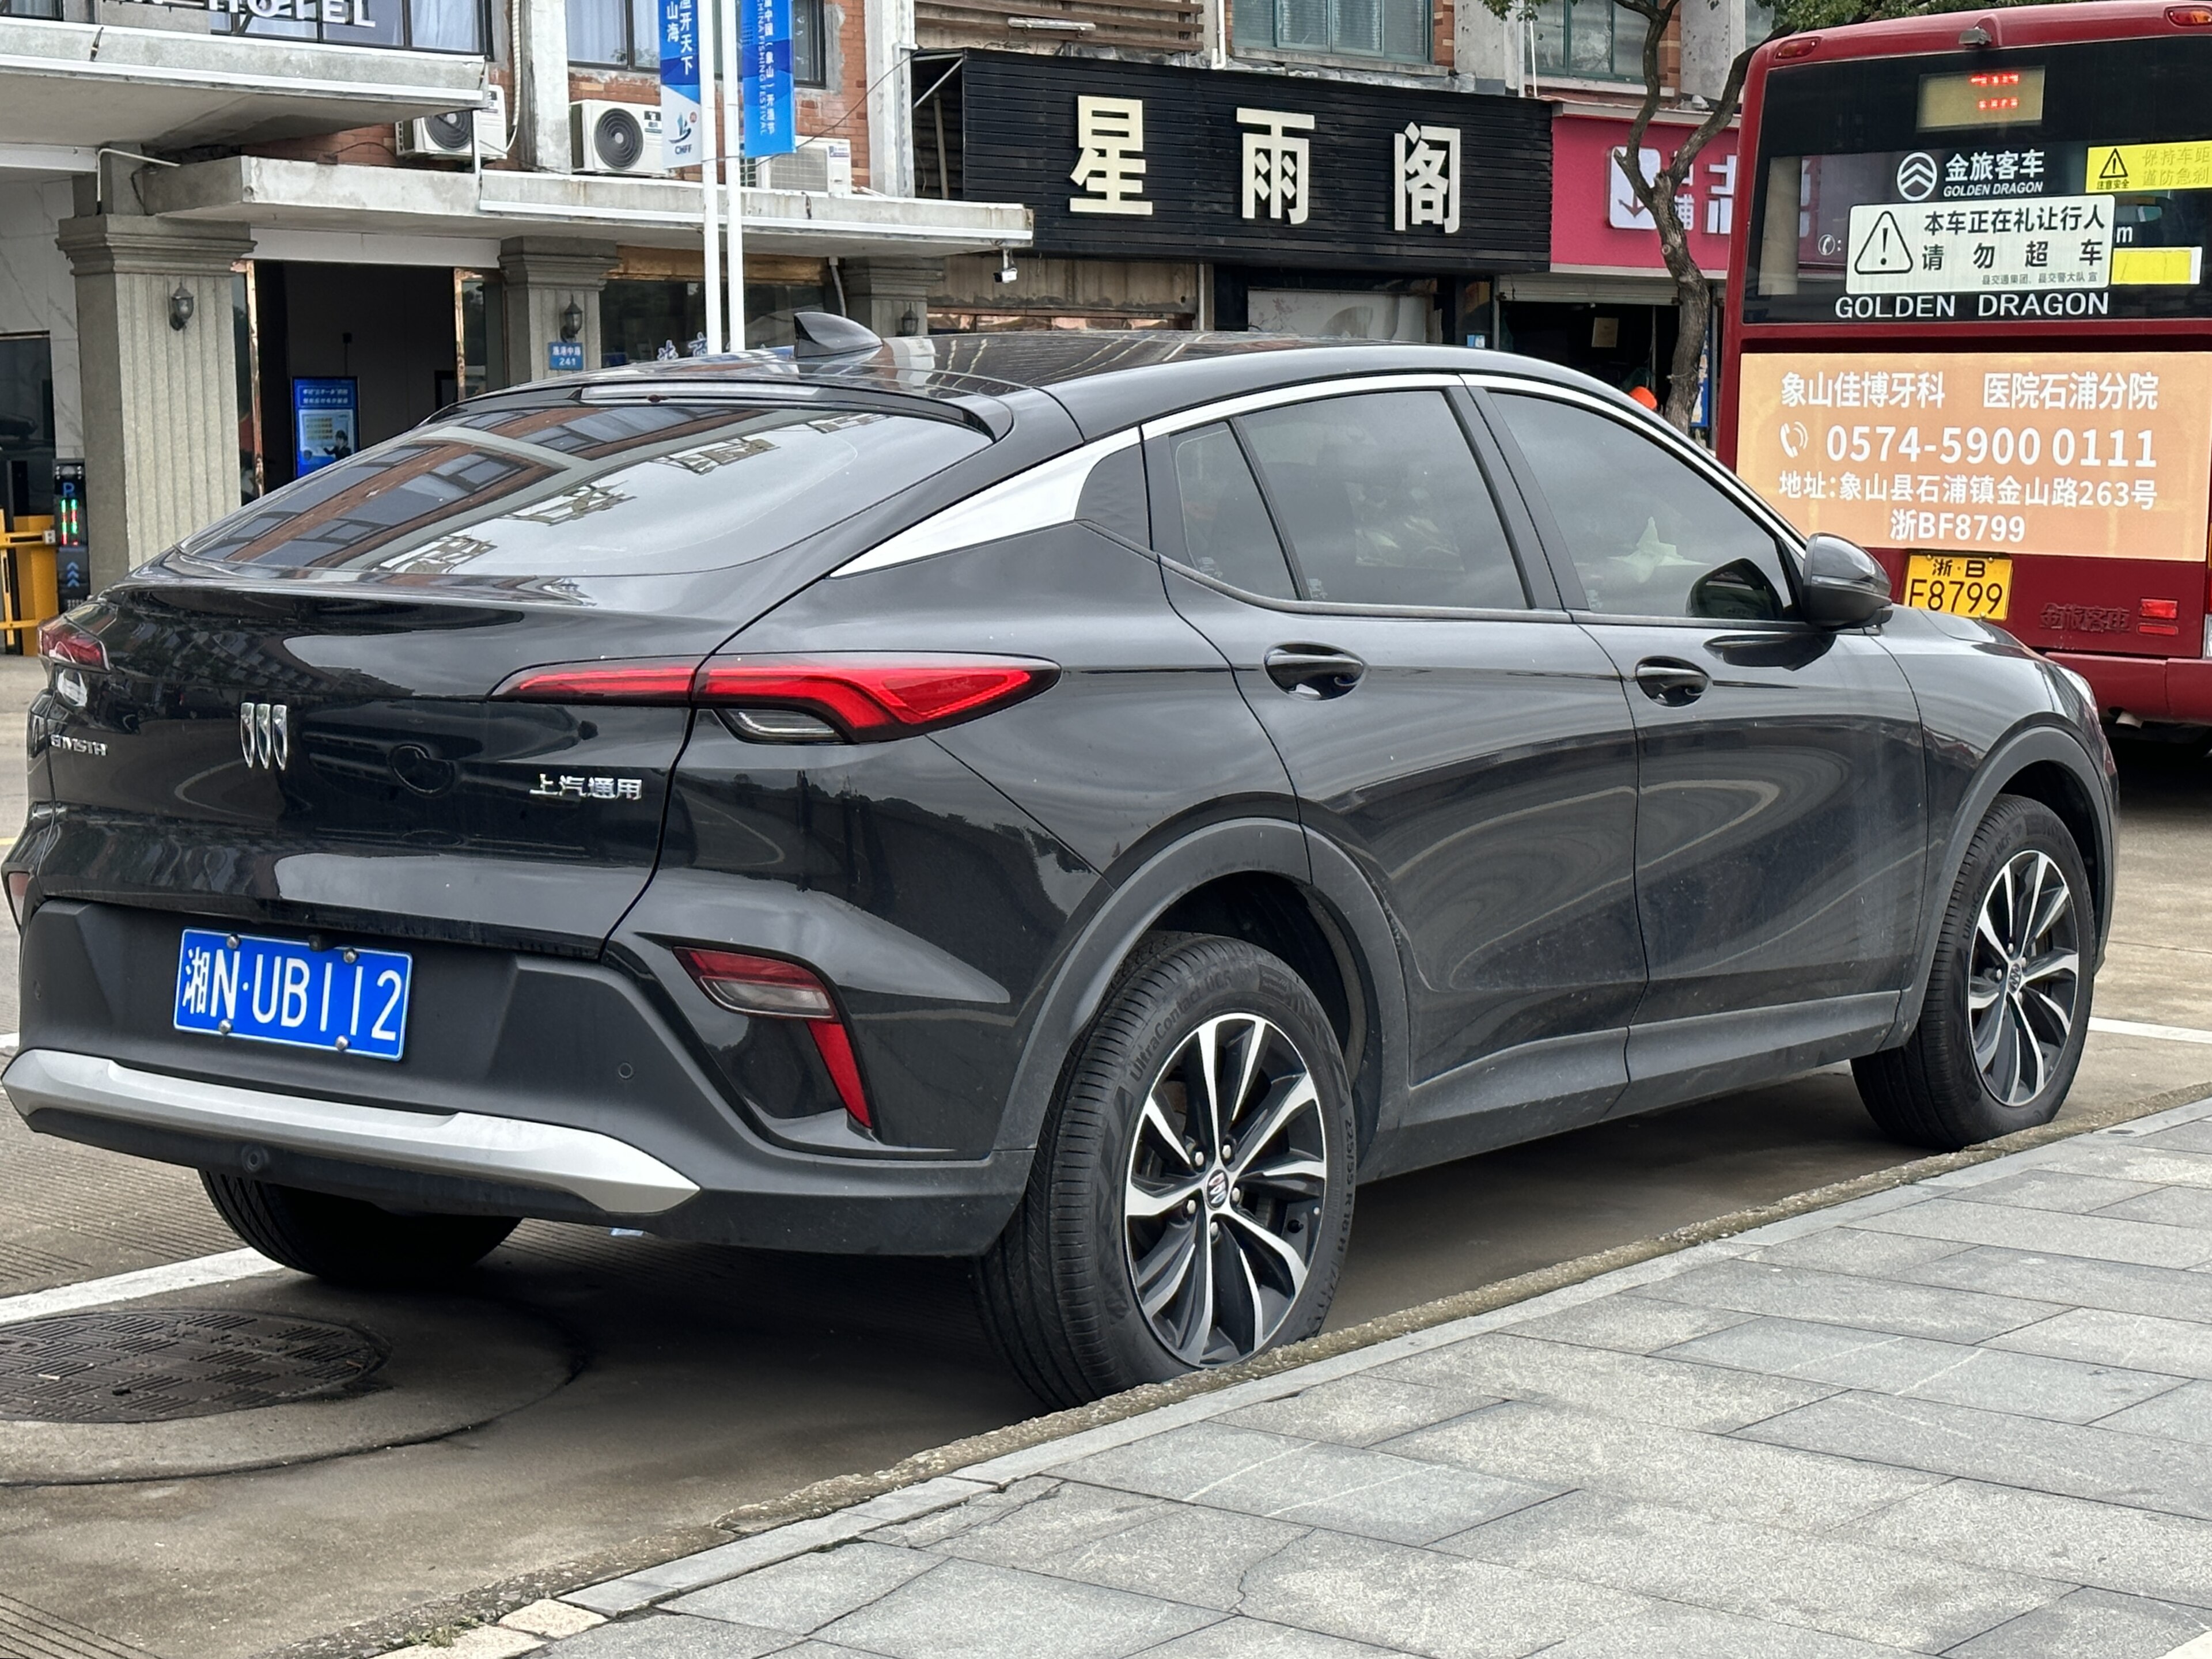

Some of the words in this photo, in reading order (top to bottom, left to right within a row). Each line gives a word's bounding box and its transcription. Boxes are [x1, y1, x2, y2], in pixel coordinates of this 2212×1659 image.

[758, 35, 766, 82] FISHING
[1069, 95, 1461, 234] 星雨阁
[1945, 149, 2044, 182] 金旅客车
[1944, 184, 1991, 197] GOLDEN
[1992, 181, 2044, 195] DRAGON
[2096, 179, 2130, 190] 注意安全
[1924, 204, 2105, 236] 本车正在礼让行人
[1835, 295, 1956, 318] GOLDEN
[1978, 291, 2109, 317] DRAGON
[559, 357, 576, 366] 241
[1781, 372, 1945, 409] 象山佳博牙科
[1983, 372, 2160, 410] 医院石浦分院
[1890, 509, 2026, 543] 浙BF8799
[1909, 578, 2003, 615] F8799
[529, 773, 642, 801] 上汽通用
[183, 946, 402, 1041] 湘N·UB112
[1130, 986, 1203, 1082] UltraContact
